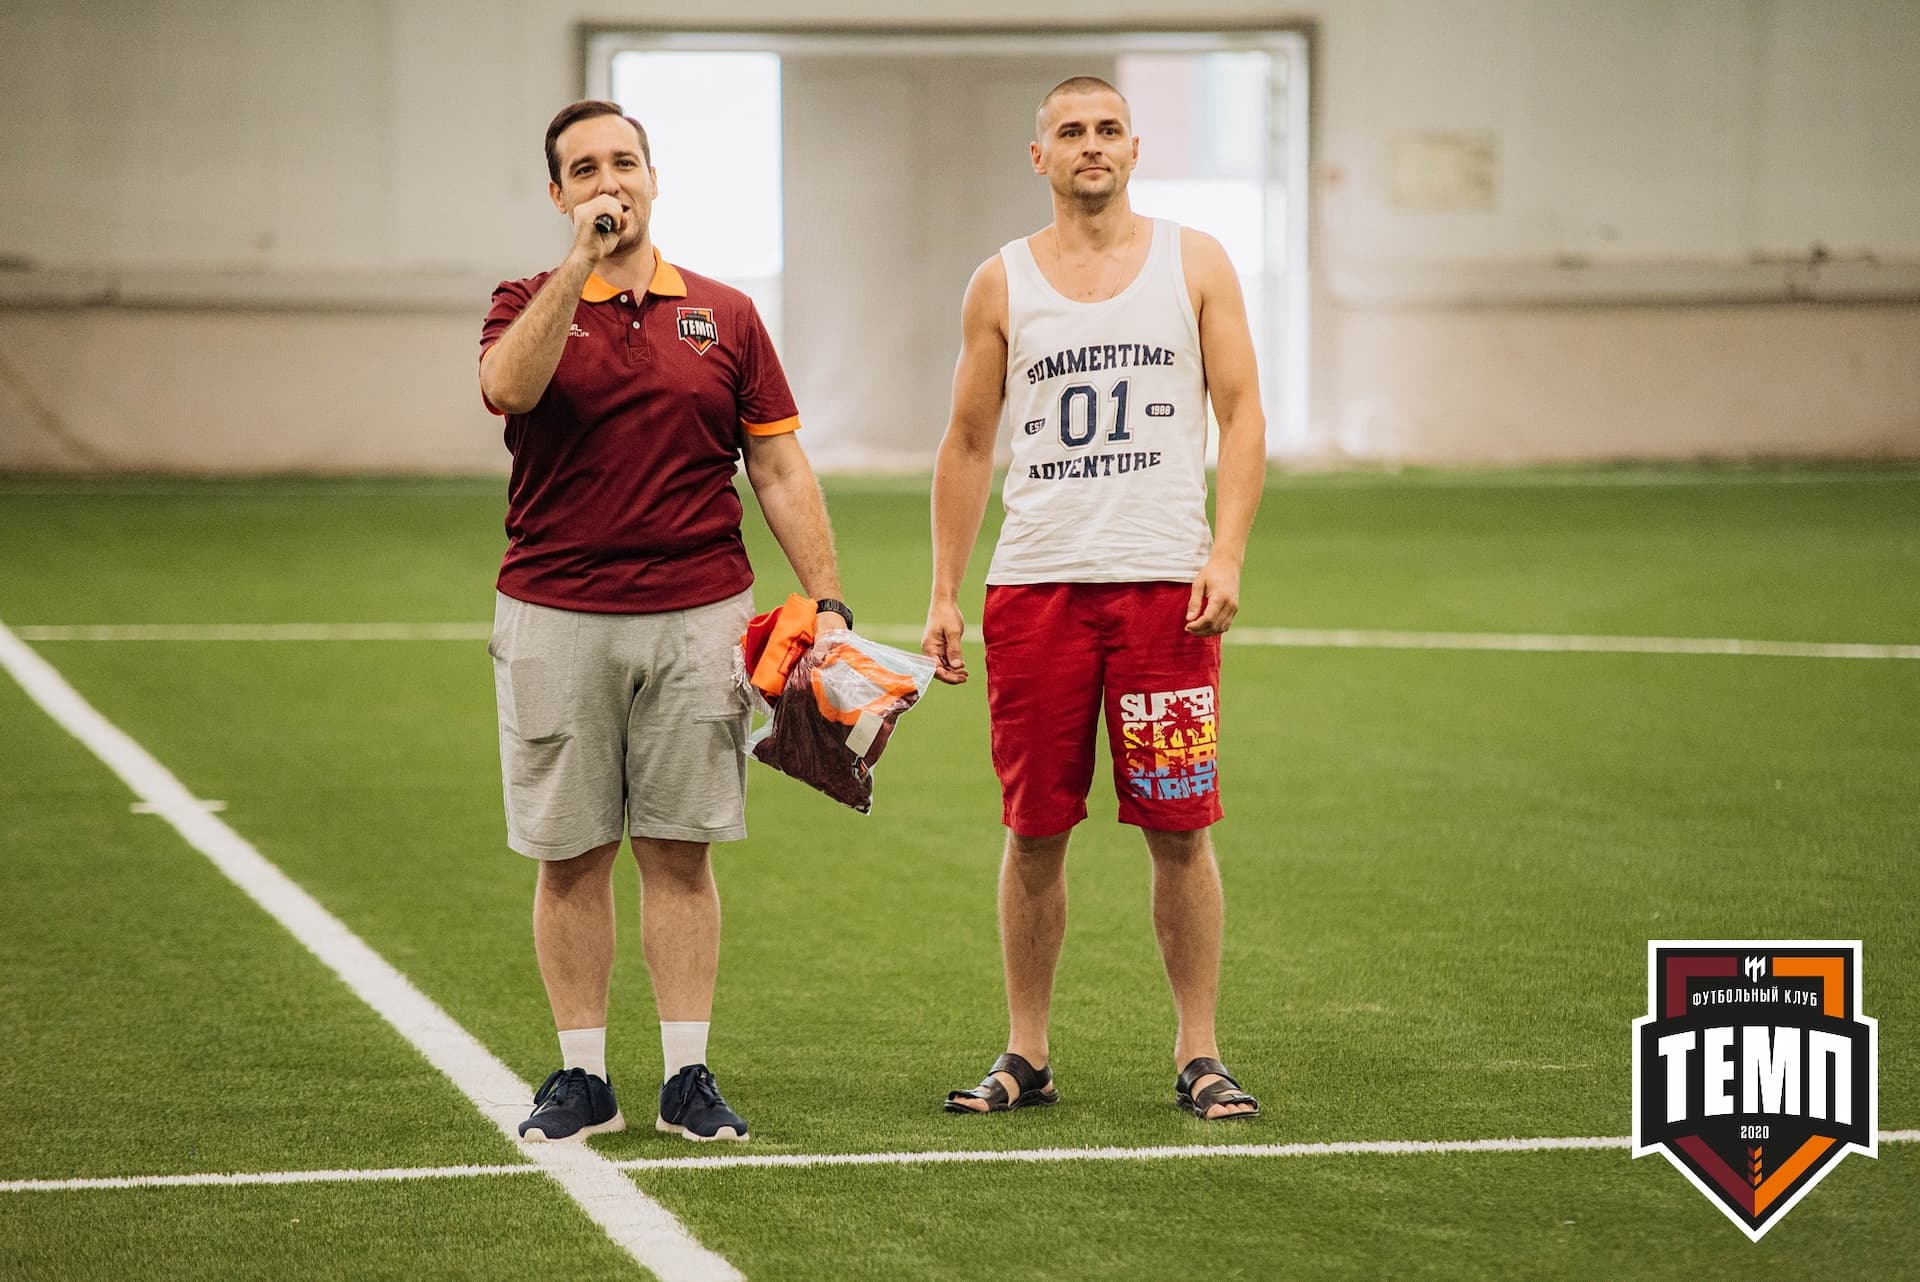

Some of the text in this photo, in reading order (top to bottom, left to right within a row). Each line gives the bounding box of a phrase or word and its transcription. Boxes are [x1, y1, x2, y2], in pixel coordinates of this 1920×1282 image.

[681, 320, 715, 339] ТЕМП
[1027, 344, 1175, 384] SUMMERTIME
[1058, 377, 1133, 450] 01
[1028, 452, 1161, 480] ADVENTURE
